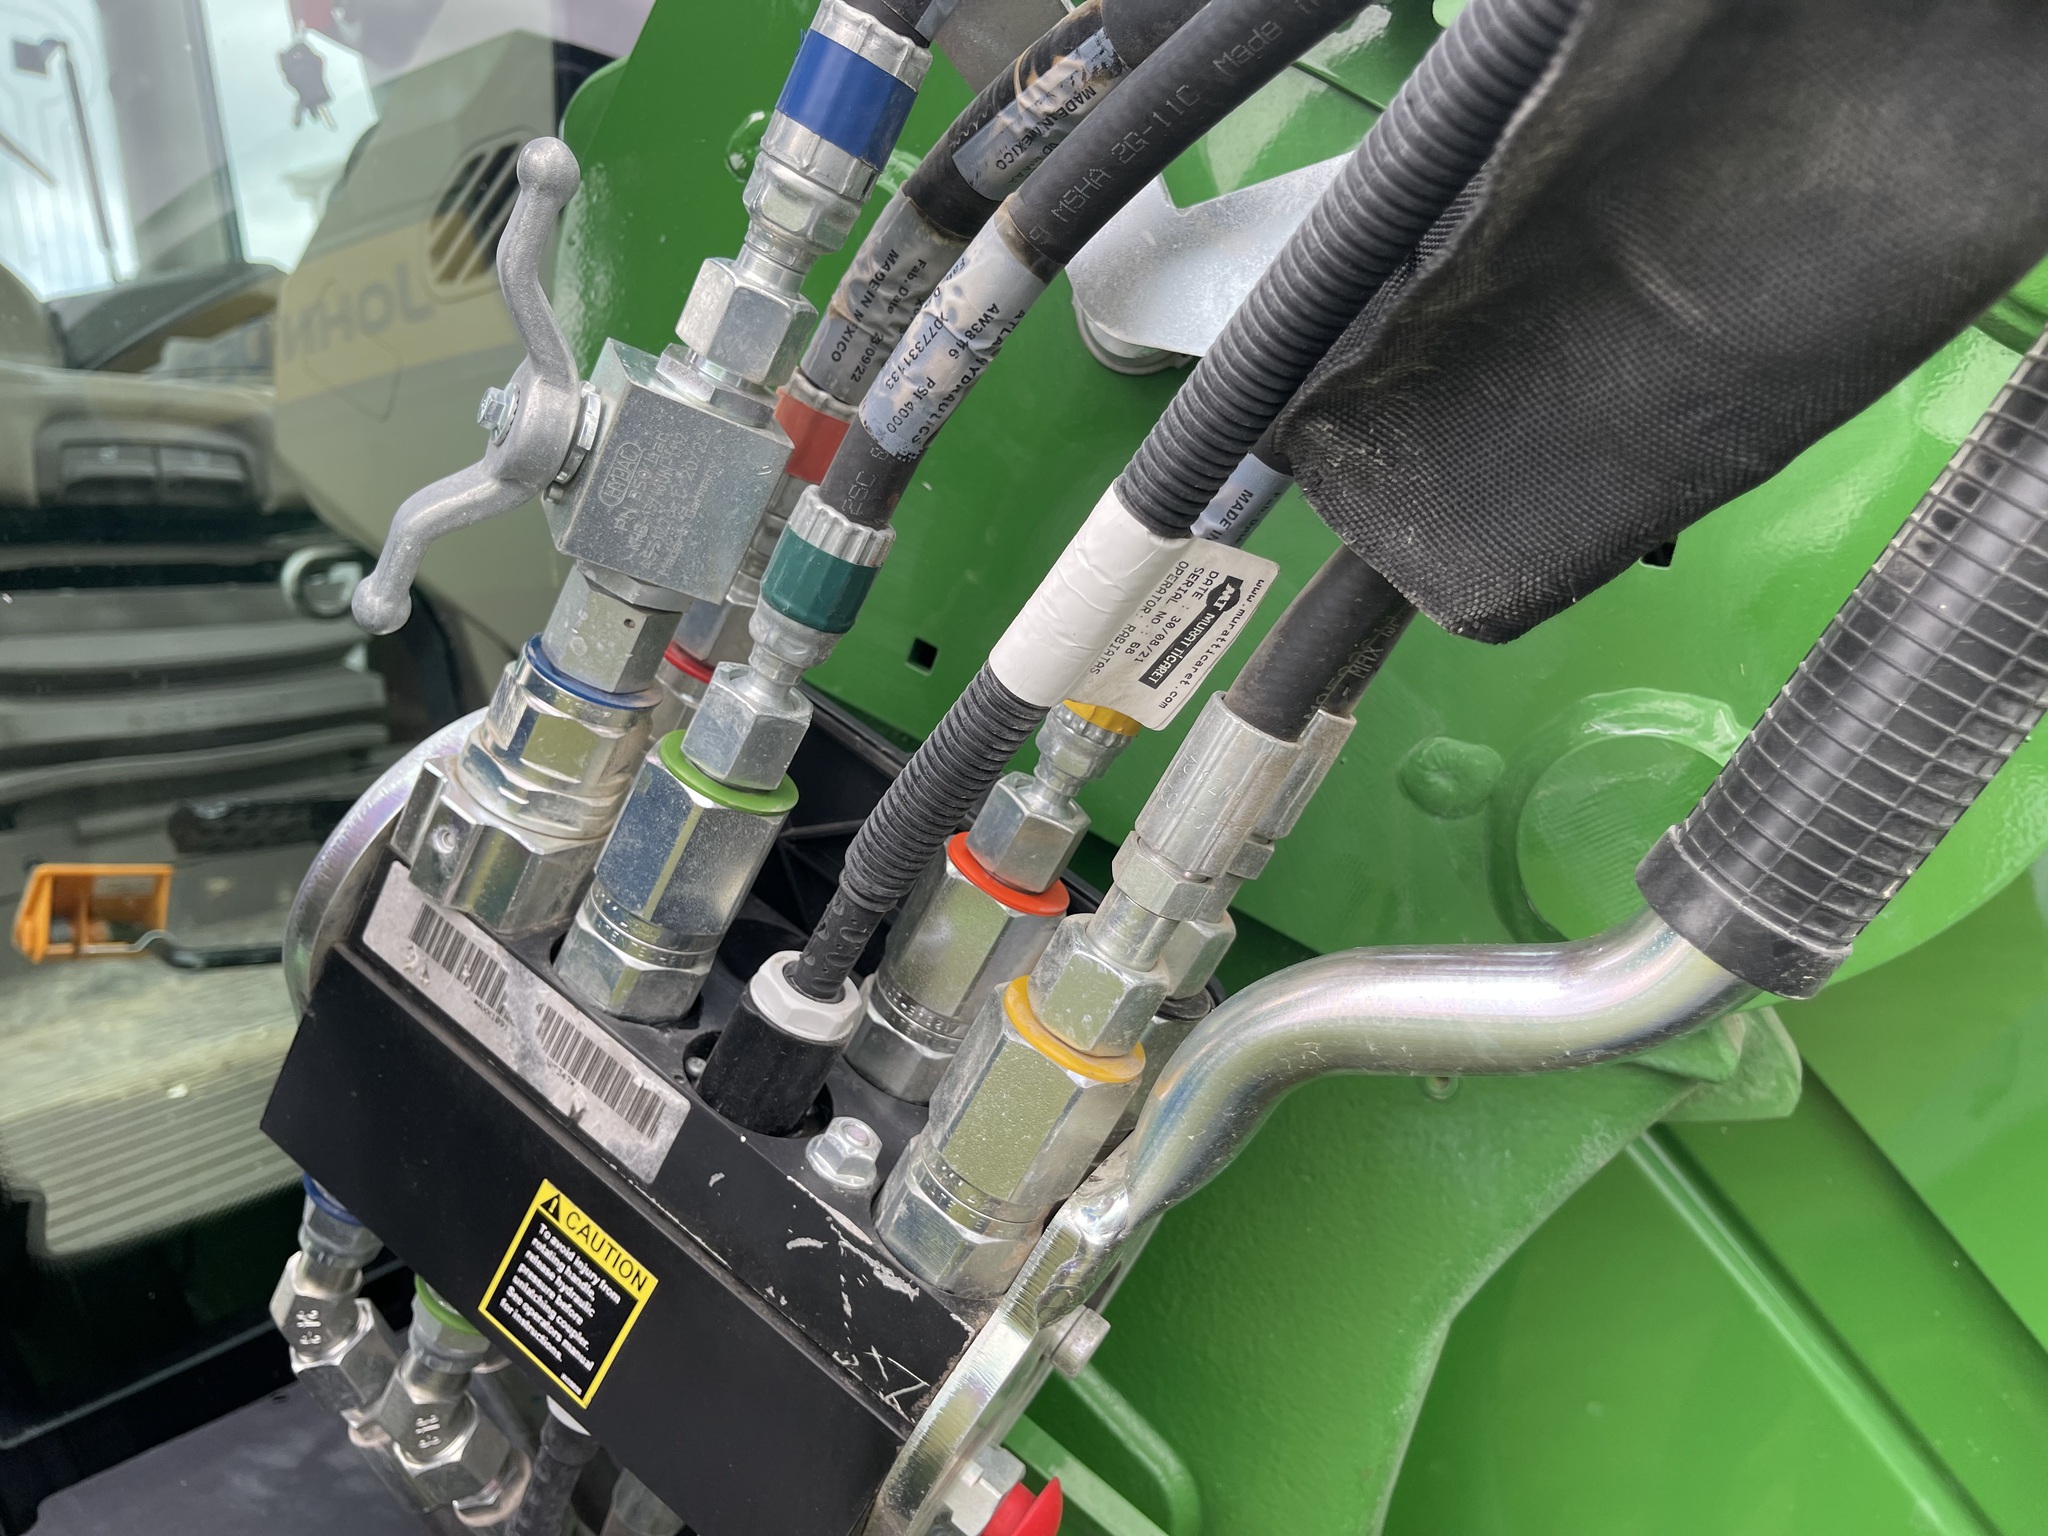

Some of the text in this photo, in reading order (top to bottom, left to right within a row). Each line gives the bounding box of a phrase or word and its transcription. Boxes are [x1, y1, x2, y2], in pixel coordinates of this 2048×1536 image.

[1055, 84, 1097, 118] MADE
[1050, 162, 1113, 225] MSHA
[1212, 20, 1285, 76] Made
[867, 248, 899, 291] MADE
[858, 289, 875, 308] IN
[885, 285, 910, 315] Date
[912, 375, 936, 401] PSI
[884, 400, 915, 434] 4000
[603, 447, 640, 500] HYDAC
[1218, 488, 1253, 530] MADE
[1164, 565, 1205, 607] SERIAL
[1190, 569, 1220, 600] DATE
[1088, 622, 1136, 676] RABIATAS
[1123, 640, 1141, 656] 68
[1132, 614, 1181, 665] 30/08/21
[1157, 577, 1265, 710] www.muratticaret.com
[1179, 611, 1216, 648] MURAT
[530, 1236, 567, 1274] rotating
[536, 1221, 622, 1305] To avoid injury from
[562, 1209, 649, 1292] CAUTION
[516, 1261, 585, 1326] pressure before
[523, 1248, 597, 1318] release hydraulic
[498, 1296, 515, 1315] for
[504, 1283, 525, 1307] See
[560, 1337, 595, 1372] manual
